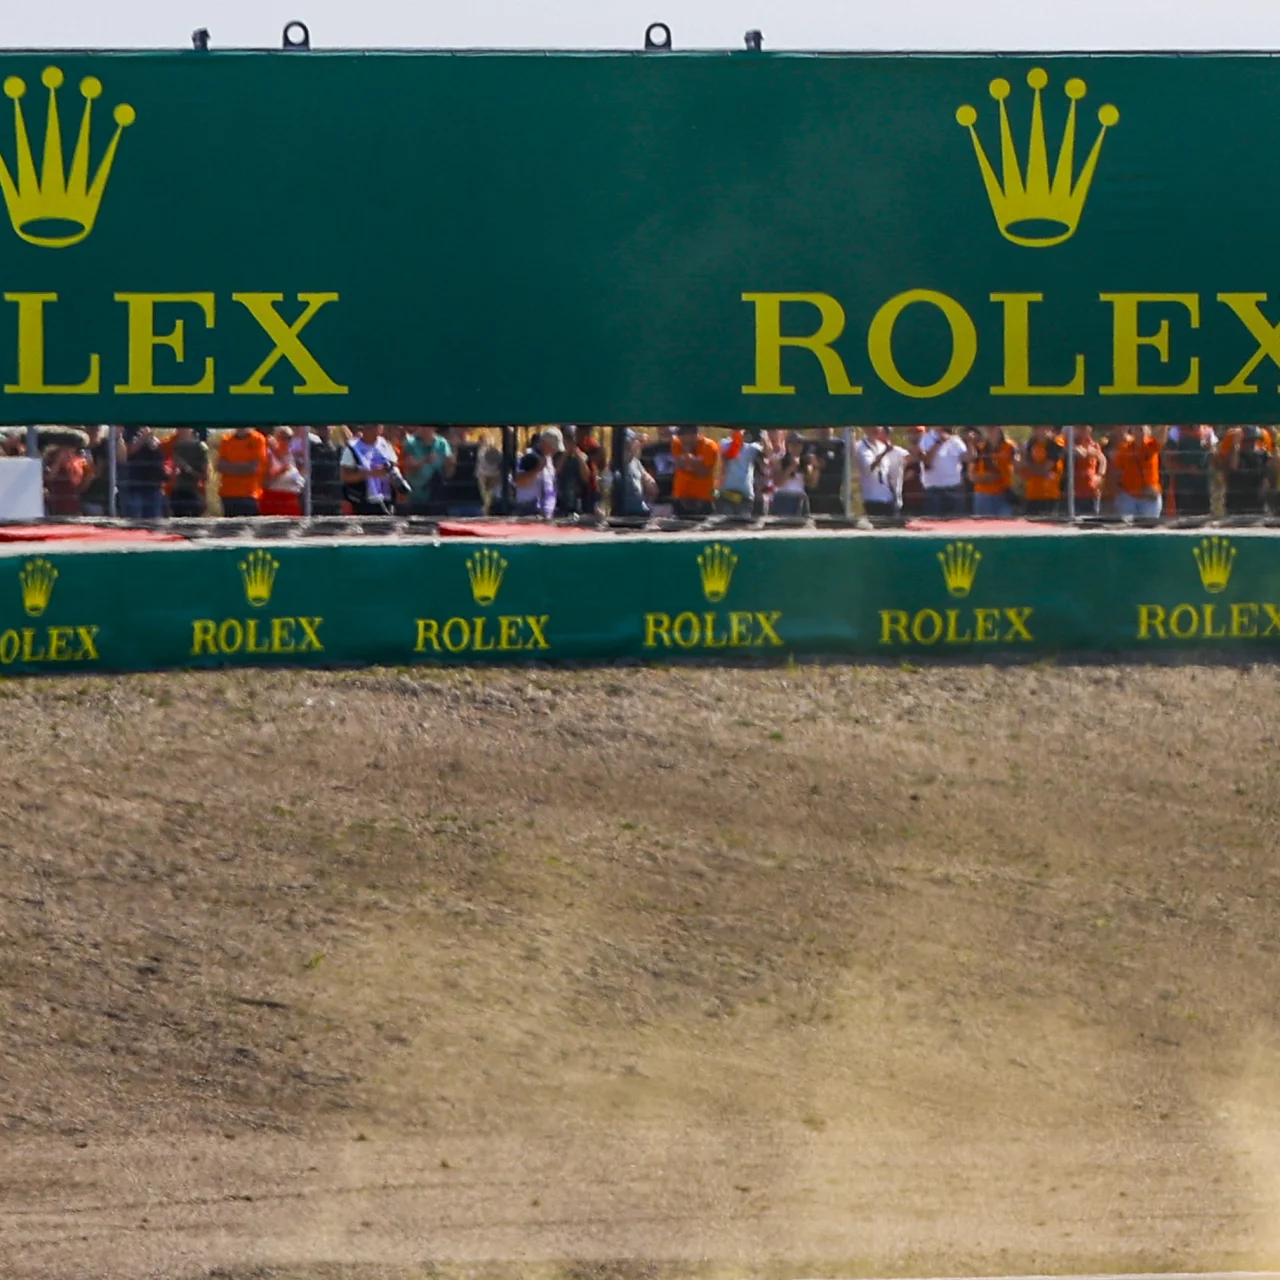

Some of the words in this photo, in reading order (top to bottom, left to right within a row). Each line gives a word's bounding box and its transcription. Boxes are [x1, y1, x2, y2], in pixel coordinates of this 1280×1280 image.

[190, 615, 324, 655] ROLEX
[414, 614, 550, 653] ROLEX
[642, 609, 784, 649] ROLEX
[883, 606, 1036, 645] ROLEX
